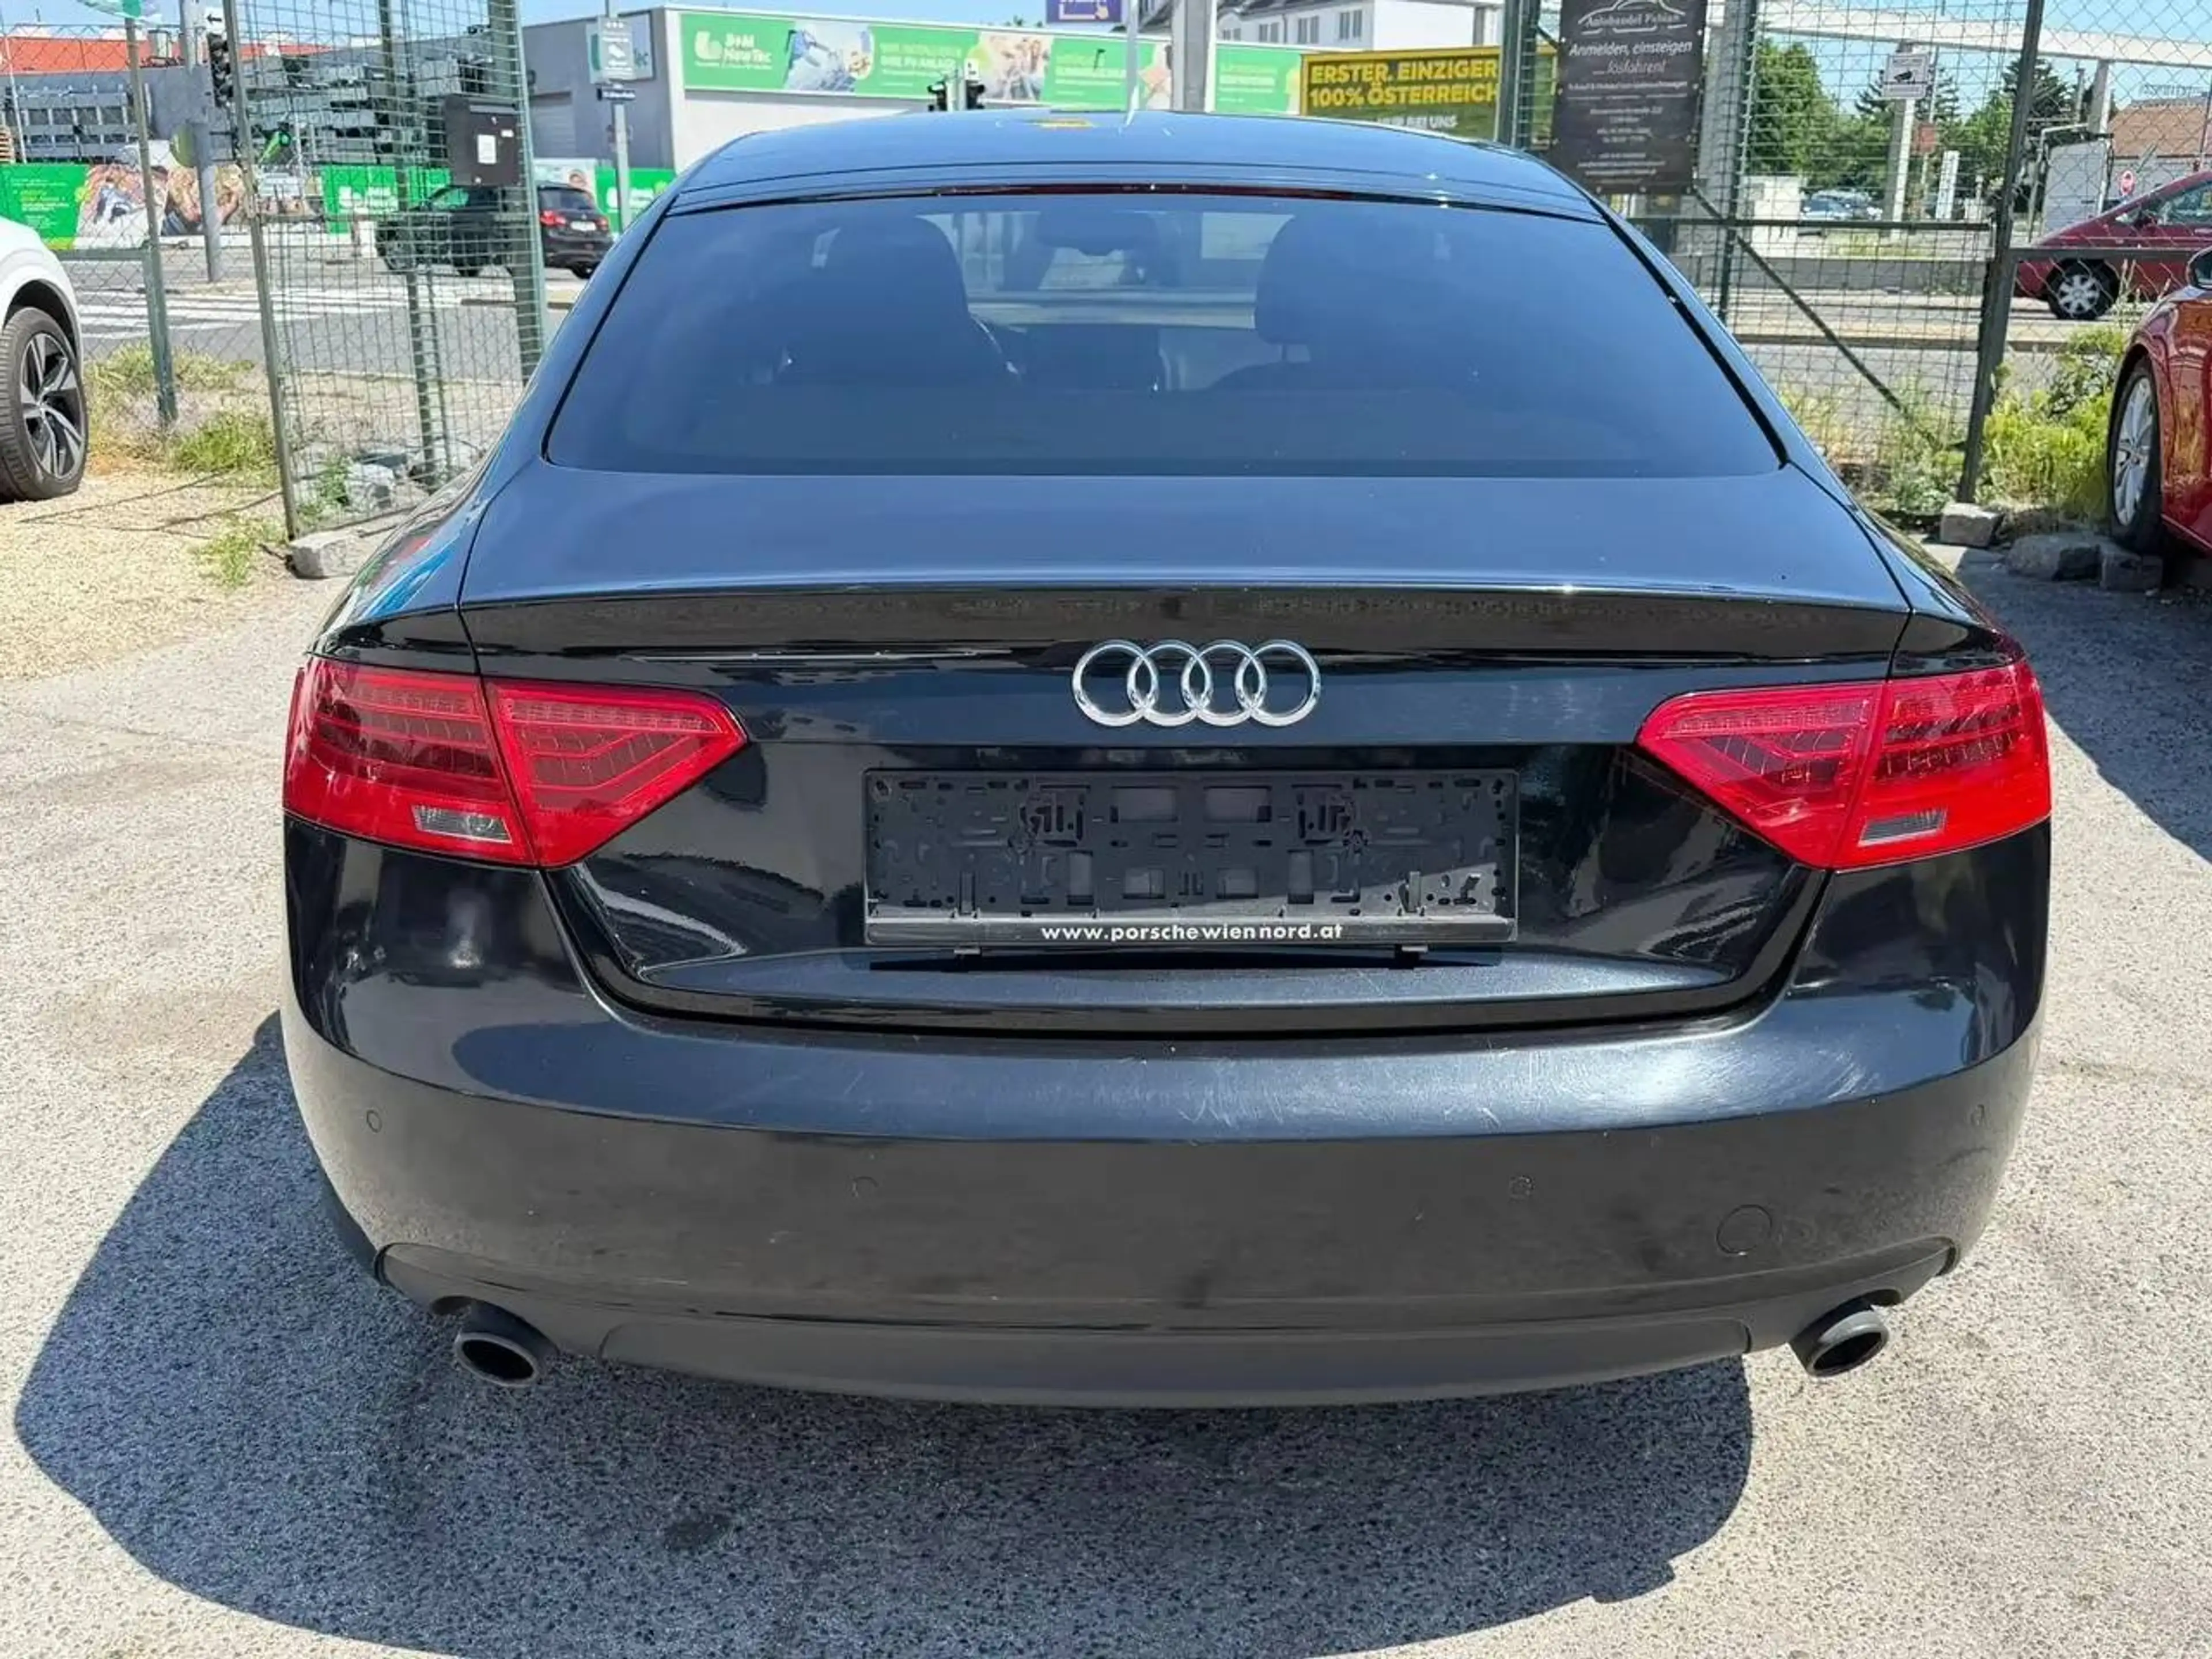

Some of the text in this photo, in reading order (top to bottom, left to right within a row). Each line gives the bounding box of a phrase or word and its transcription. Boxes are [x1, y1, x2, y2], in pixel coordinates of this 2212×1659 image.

[1632, 41, 1692, 56] einsteigen
[1310, 59, 1498, 84] ERSTER. EINZIGER
[1309, 81, 1498, 107] 100% ÖSTERREICH
[1429, 115, 1459, 128] UNS
[1041, 924, 1344, 941] www.porschewiennord.at
